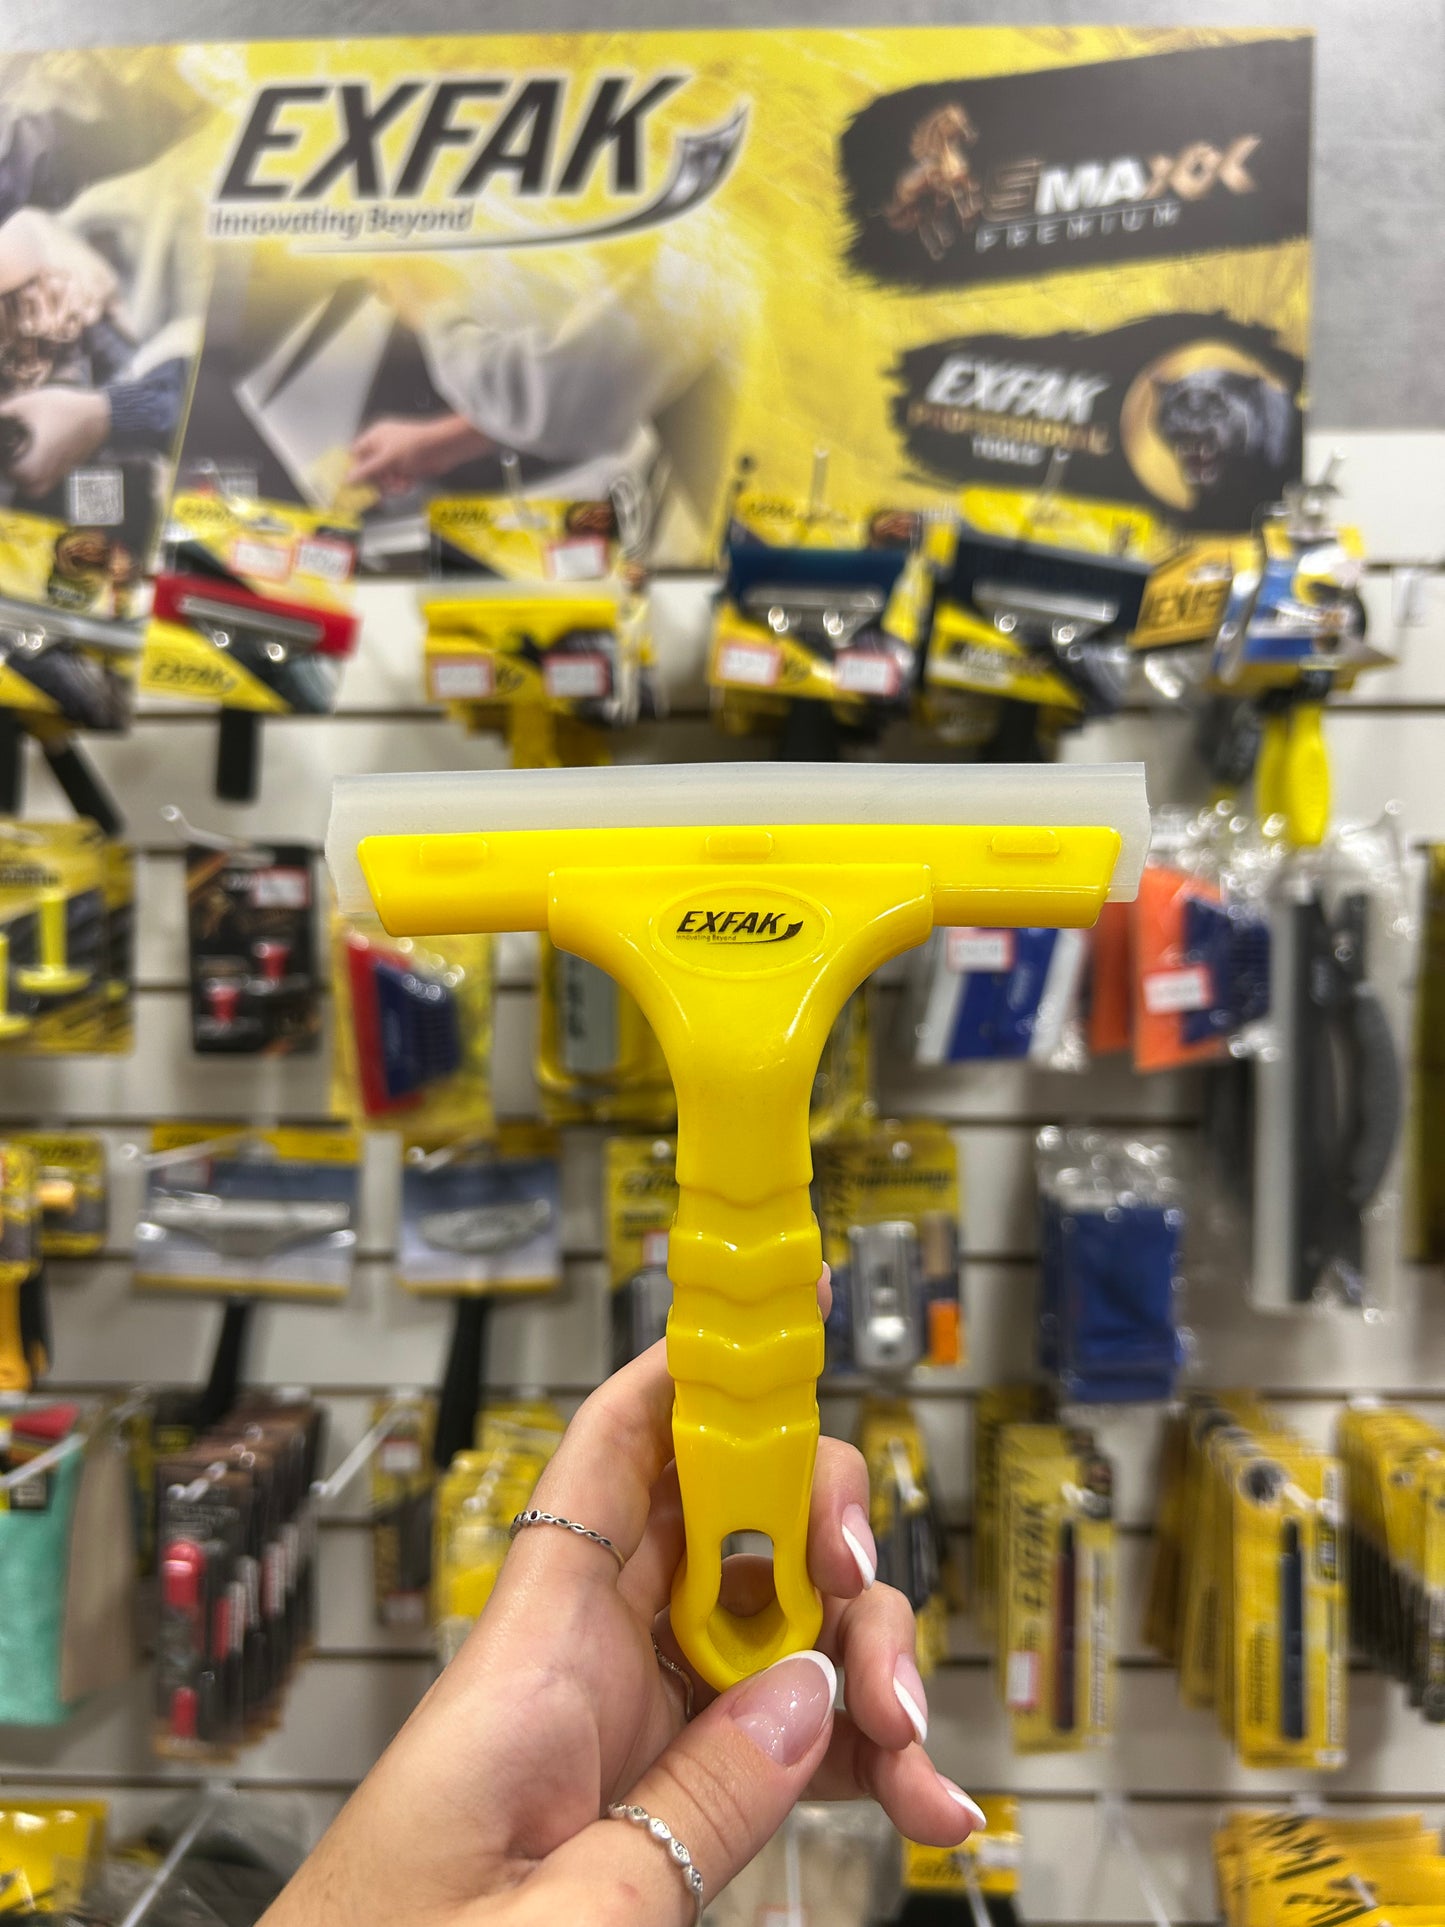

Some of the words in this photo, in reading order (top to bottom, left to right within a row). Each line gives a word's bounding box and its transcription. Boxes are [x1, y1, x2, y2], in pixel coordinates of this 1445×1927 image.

[216, 74, 692, 200] EXFAK
[214, 208, 363, 239] Innovating
[368, 206, 472, 237] Beyond
[974, 200, 1183, 253] PREMIUM
[925, 355, 1113, 425] EXFAK
[675, 934, 711, 943] Innovating
[711, 934, 737, 942] Beyond
[676, 910, 787, 934] EXFAK
